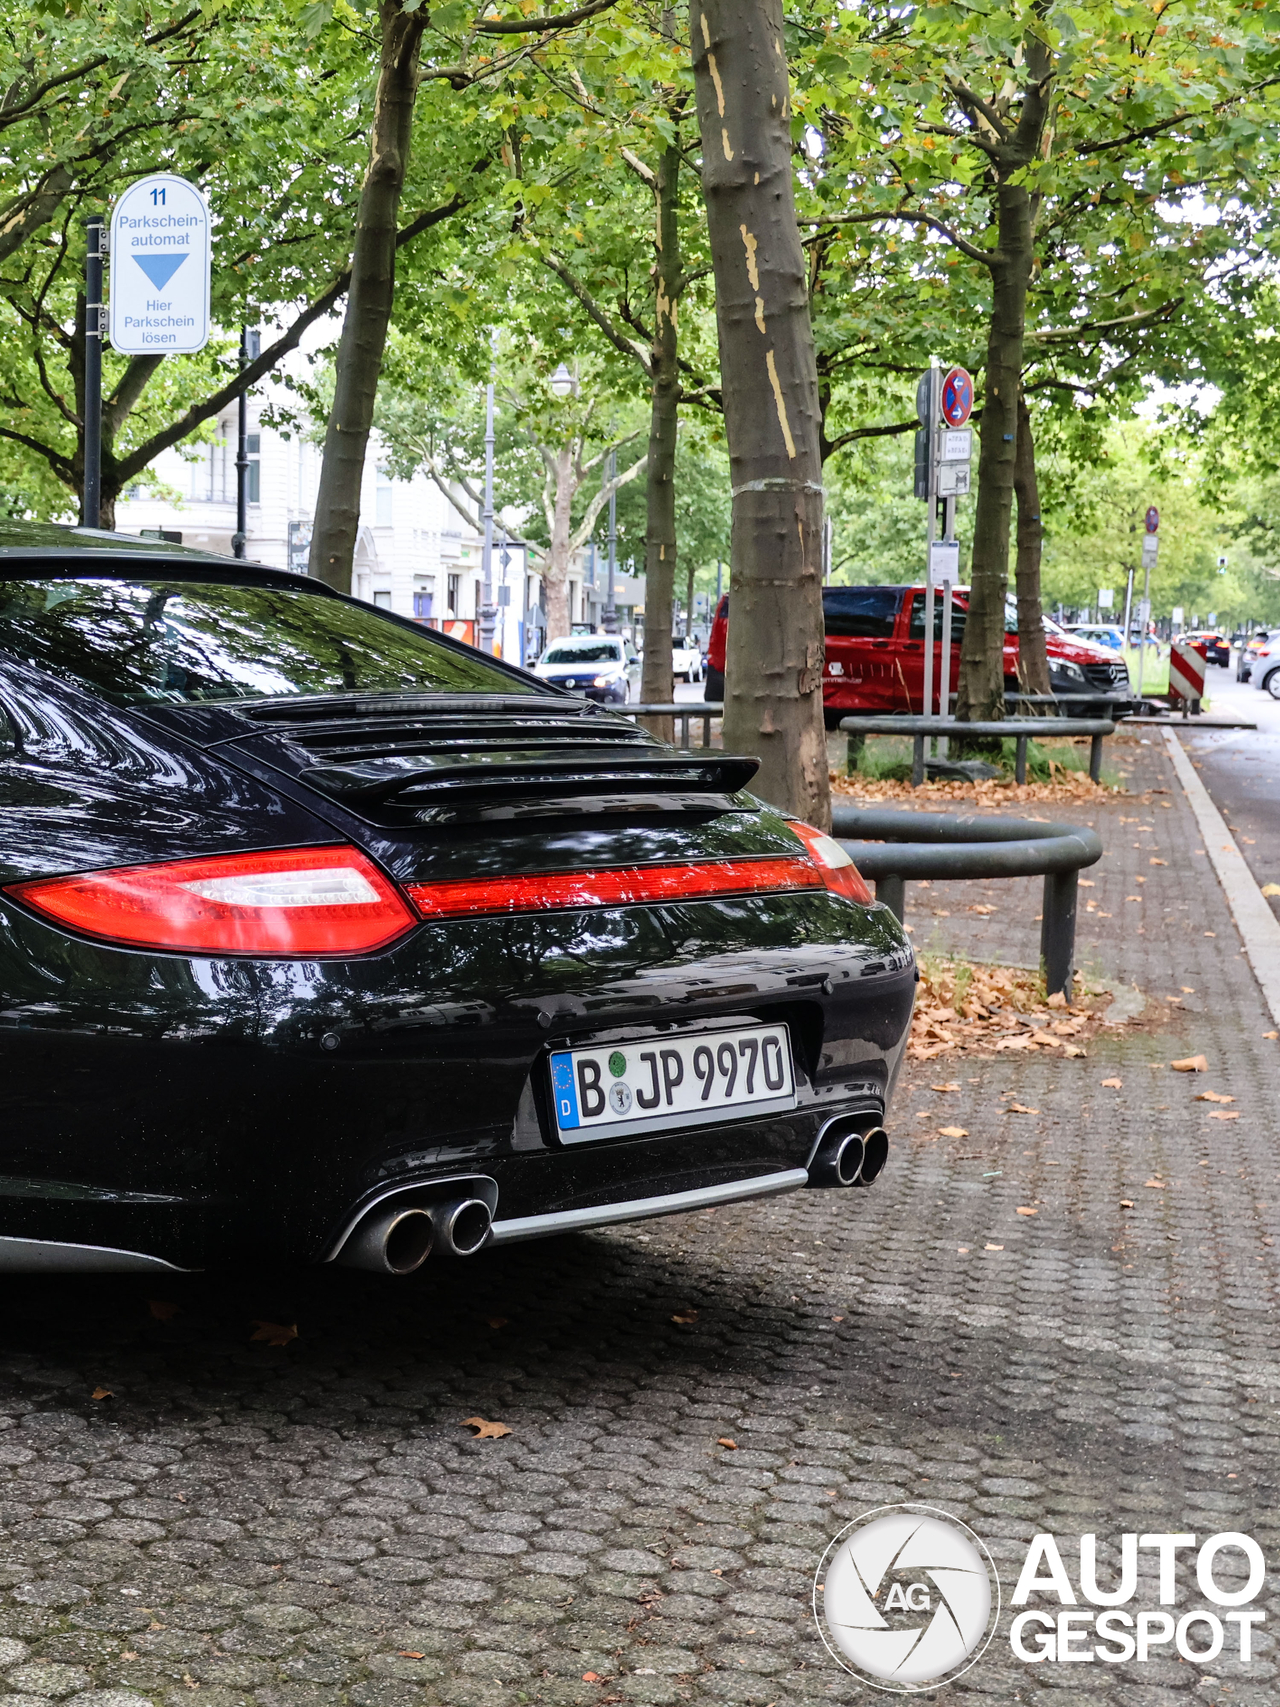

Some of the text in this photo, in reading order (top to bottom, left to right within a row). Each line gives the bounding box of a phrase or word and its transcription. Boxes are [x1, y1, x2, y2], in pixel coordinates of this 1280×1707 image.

[149, 188, 166, 206] 11
[119, 213, 204, 229] Parkschein-
[131, 232, 191, 247] automat
[146, 299, 173, 312] Hier
[124, 315, 195, 328] Parkschein
[142, 332, 177, 344] lösen
[577, 1035, 784, 1118] B JP 9970
[561, 1099, 572, 1116] D
